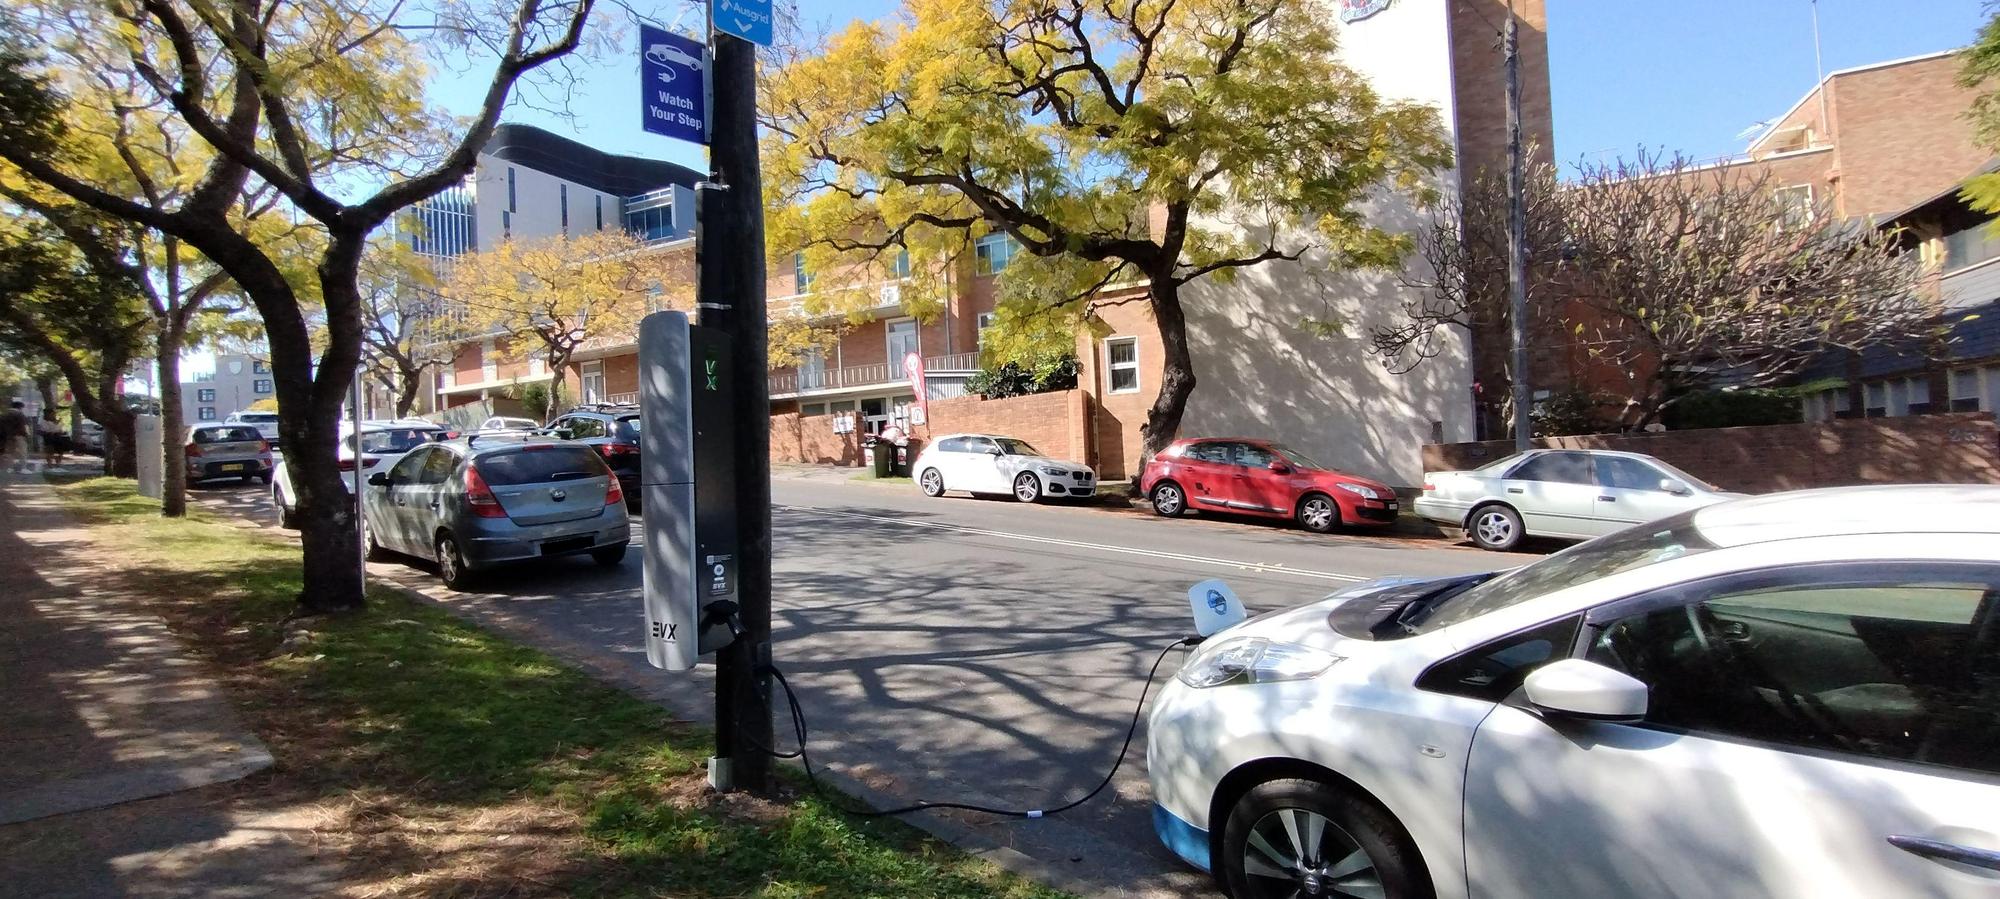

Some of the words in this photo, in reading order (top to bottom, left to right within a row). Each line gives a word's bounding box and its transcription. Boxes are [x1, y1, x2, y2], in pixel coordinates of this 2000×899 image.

[733, 2, 769, 24] Ausgrid
[658, 90, 694, 110] Watch
[650, 104, 676, 122] Your
[678, 112, 703, 131] Step
[652, 621, 678, 640] EVX
